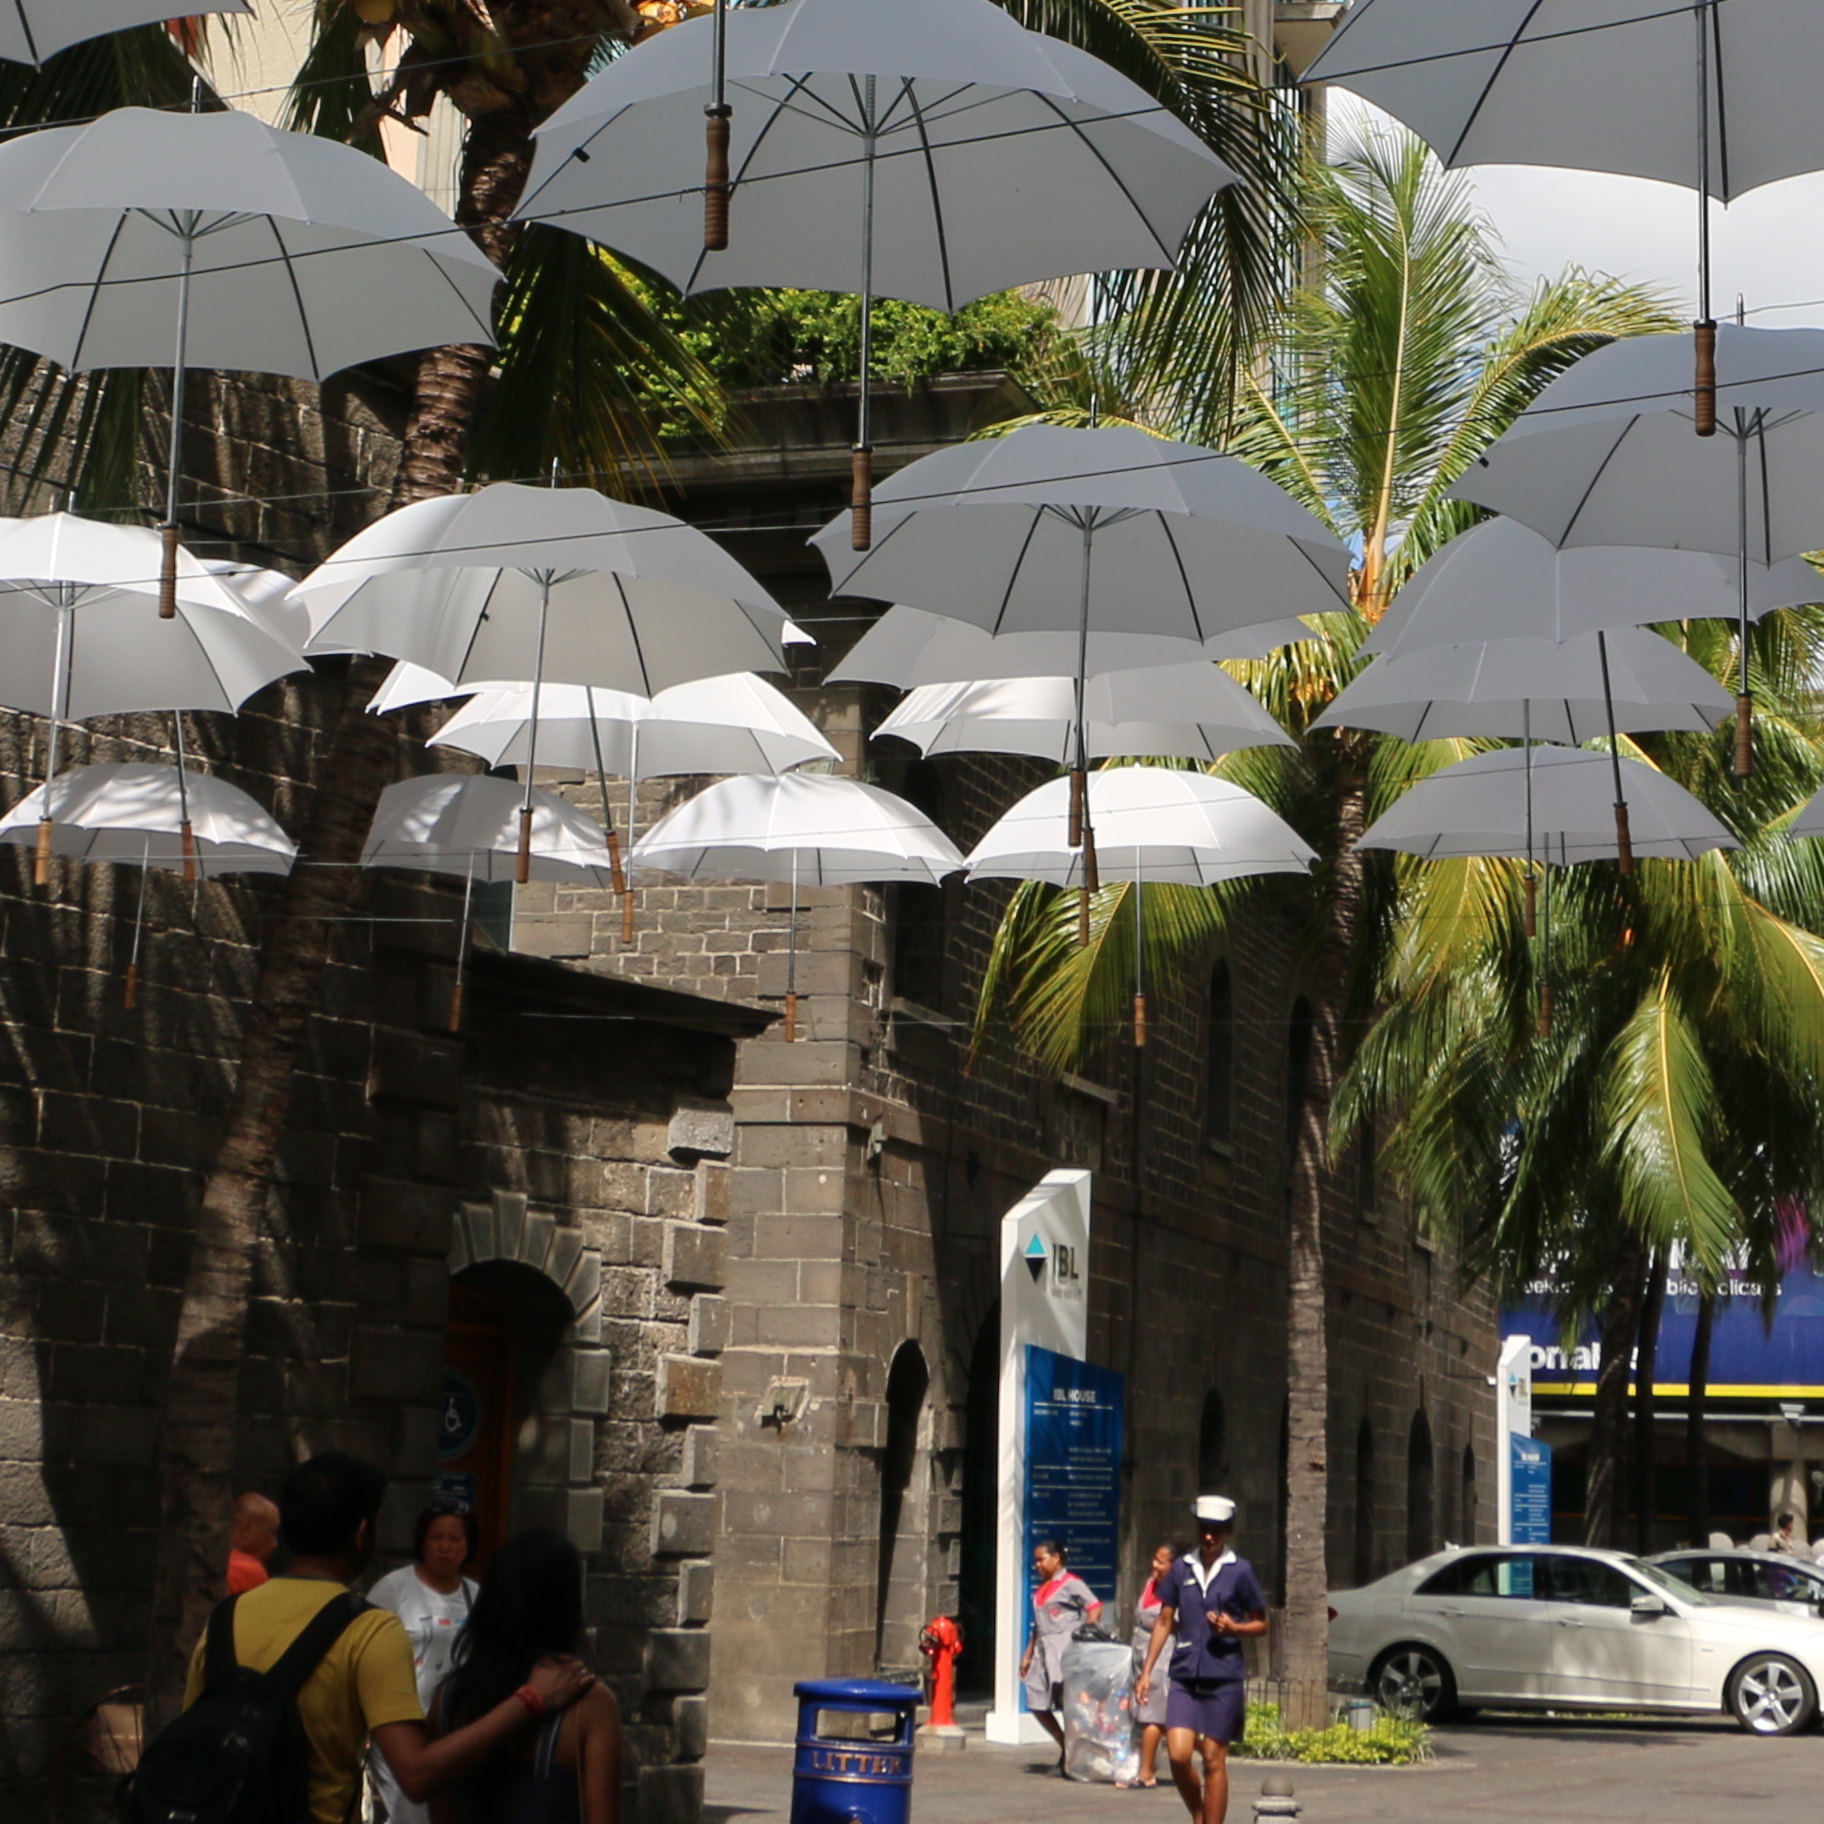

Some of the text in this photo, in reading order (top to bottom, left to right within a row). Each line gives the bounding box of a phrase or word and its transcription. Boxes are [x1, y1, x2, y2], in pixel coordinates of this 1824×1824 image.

[1053, 1243, 1079, 1280] IBL
[1067, 1389, 1096, 1403] HOUSE
[812, 1751, 902, 1774] LITTER
